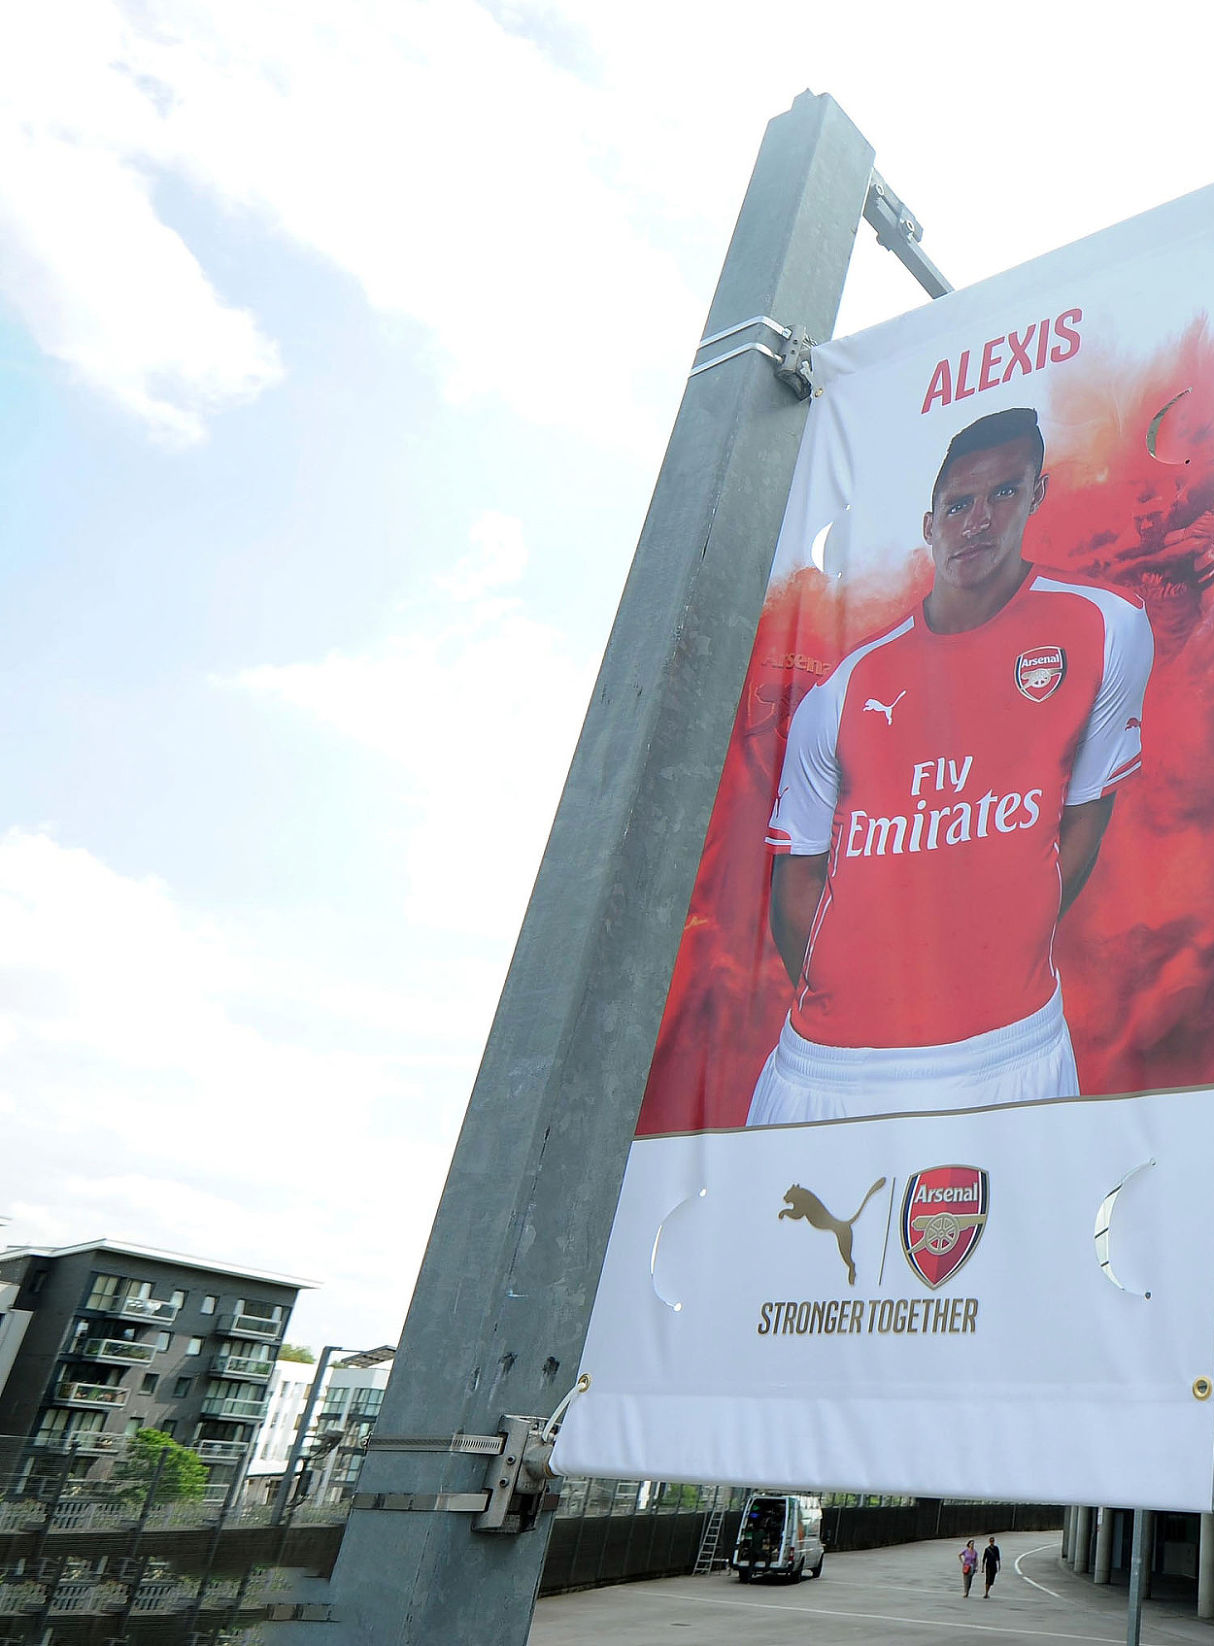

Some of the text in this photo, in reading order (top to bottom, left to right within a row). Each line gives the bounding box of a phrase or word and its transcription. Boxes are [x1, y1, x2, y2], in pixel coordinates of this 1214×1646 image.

[921, 308, 1083, 415] ALEXIS
[1021, 653, 1060, 668] Arsenal
[911, 756, 973, 796] Fly
[846, 788, 1043, 858] Emirates
[914, 1182, 978, 1204] Arsenal
[757, 1298, 979, 1335] STRONGER TOGETHER
